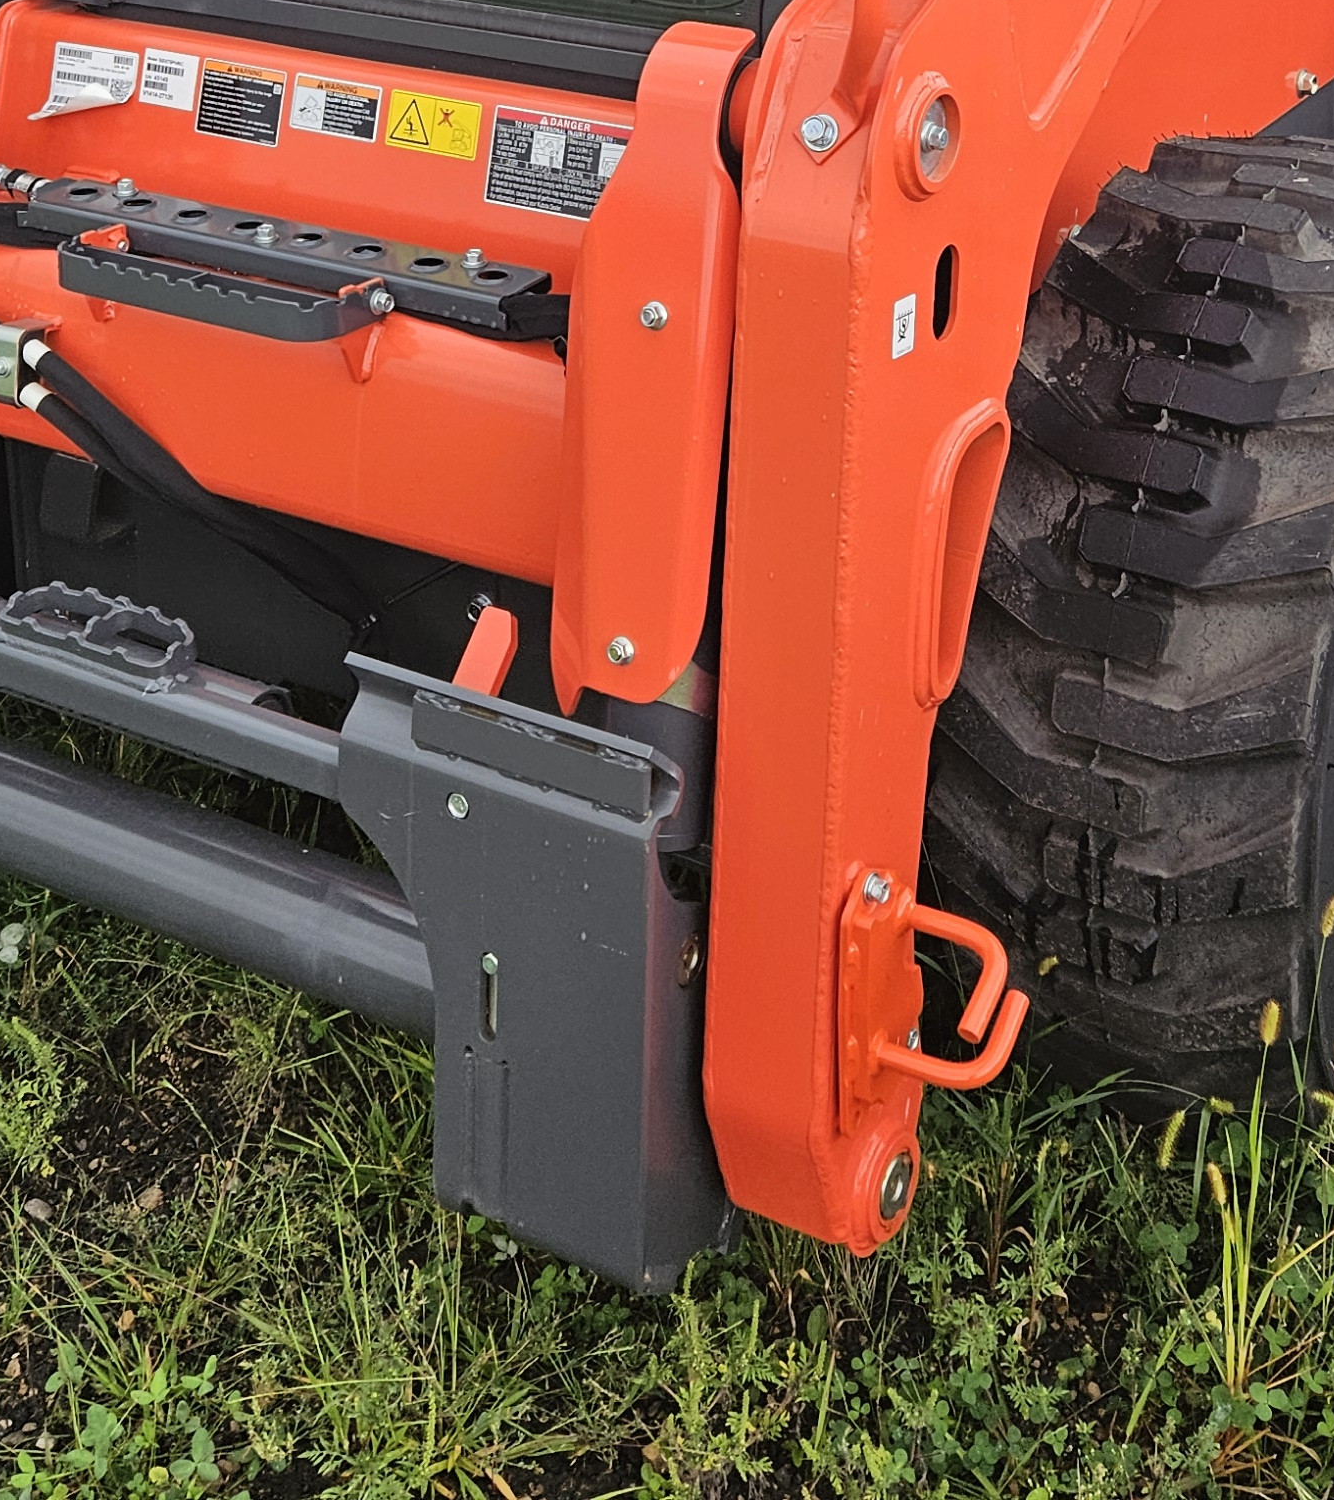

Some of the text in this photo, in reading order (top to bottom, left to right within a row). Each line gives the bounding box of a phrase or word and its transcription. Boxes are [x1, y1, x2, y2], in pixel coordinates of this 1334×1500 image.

[324, 81, 358, 94] WARNING
[539, 125, 567, 136] PERSONAL
[550, 117, 591, 132] DANGER
